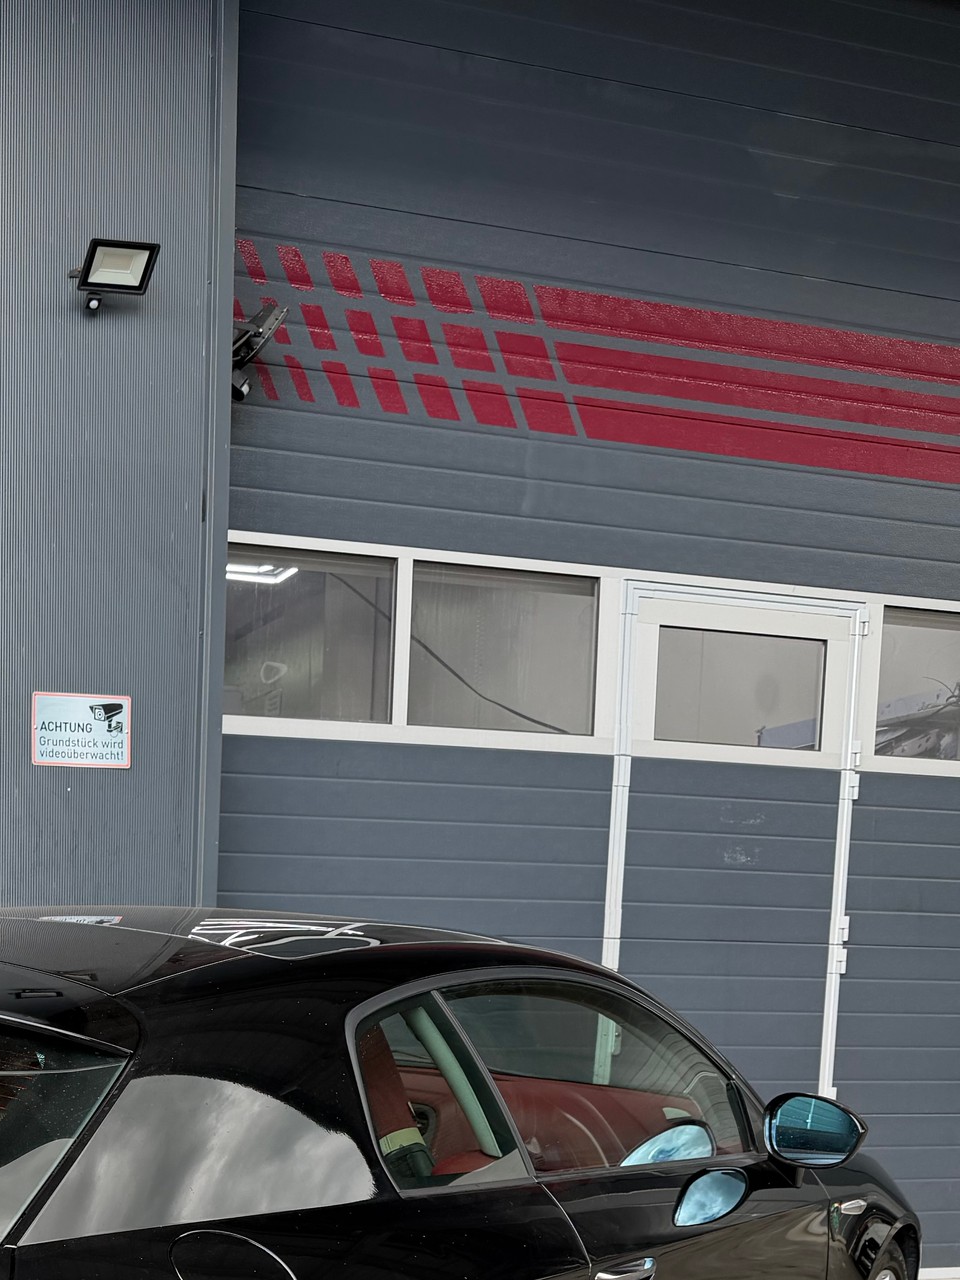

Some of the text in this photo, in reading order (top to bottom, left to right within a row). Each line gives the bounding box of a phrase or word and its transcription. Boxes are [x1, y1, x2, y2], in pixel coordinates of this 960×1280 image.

[40, 721, 93, 733] ACHTUNG
[39, 736, 124, 749] Grundstück wird
[39, 748, 124, 761] videoüberwacht!
